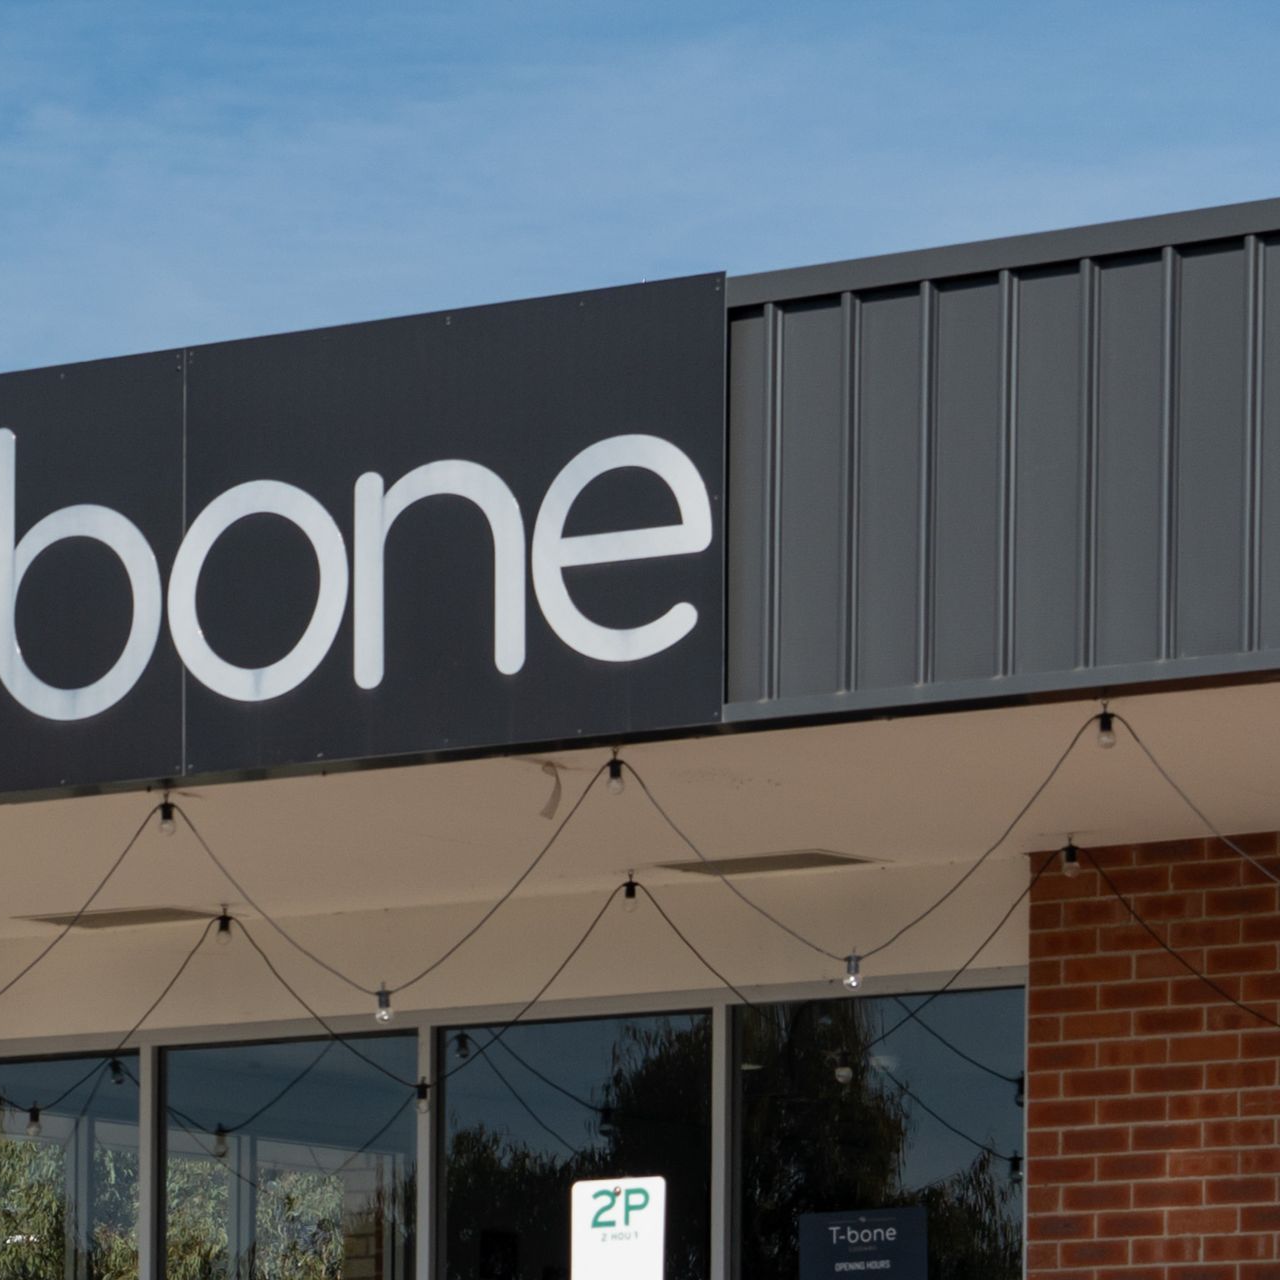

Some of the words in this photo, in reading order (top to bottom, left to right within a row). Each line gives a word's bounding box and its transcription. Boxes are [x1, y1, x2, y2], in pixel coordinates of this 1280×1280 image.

[591, 1187, 650, 1228] 2P
[828, 1226, 897, 1245] T-bone
[834, 1261, 866, 1272] OPENING
[866, 1259, 891, 1270] HOURS
